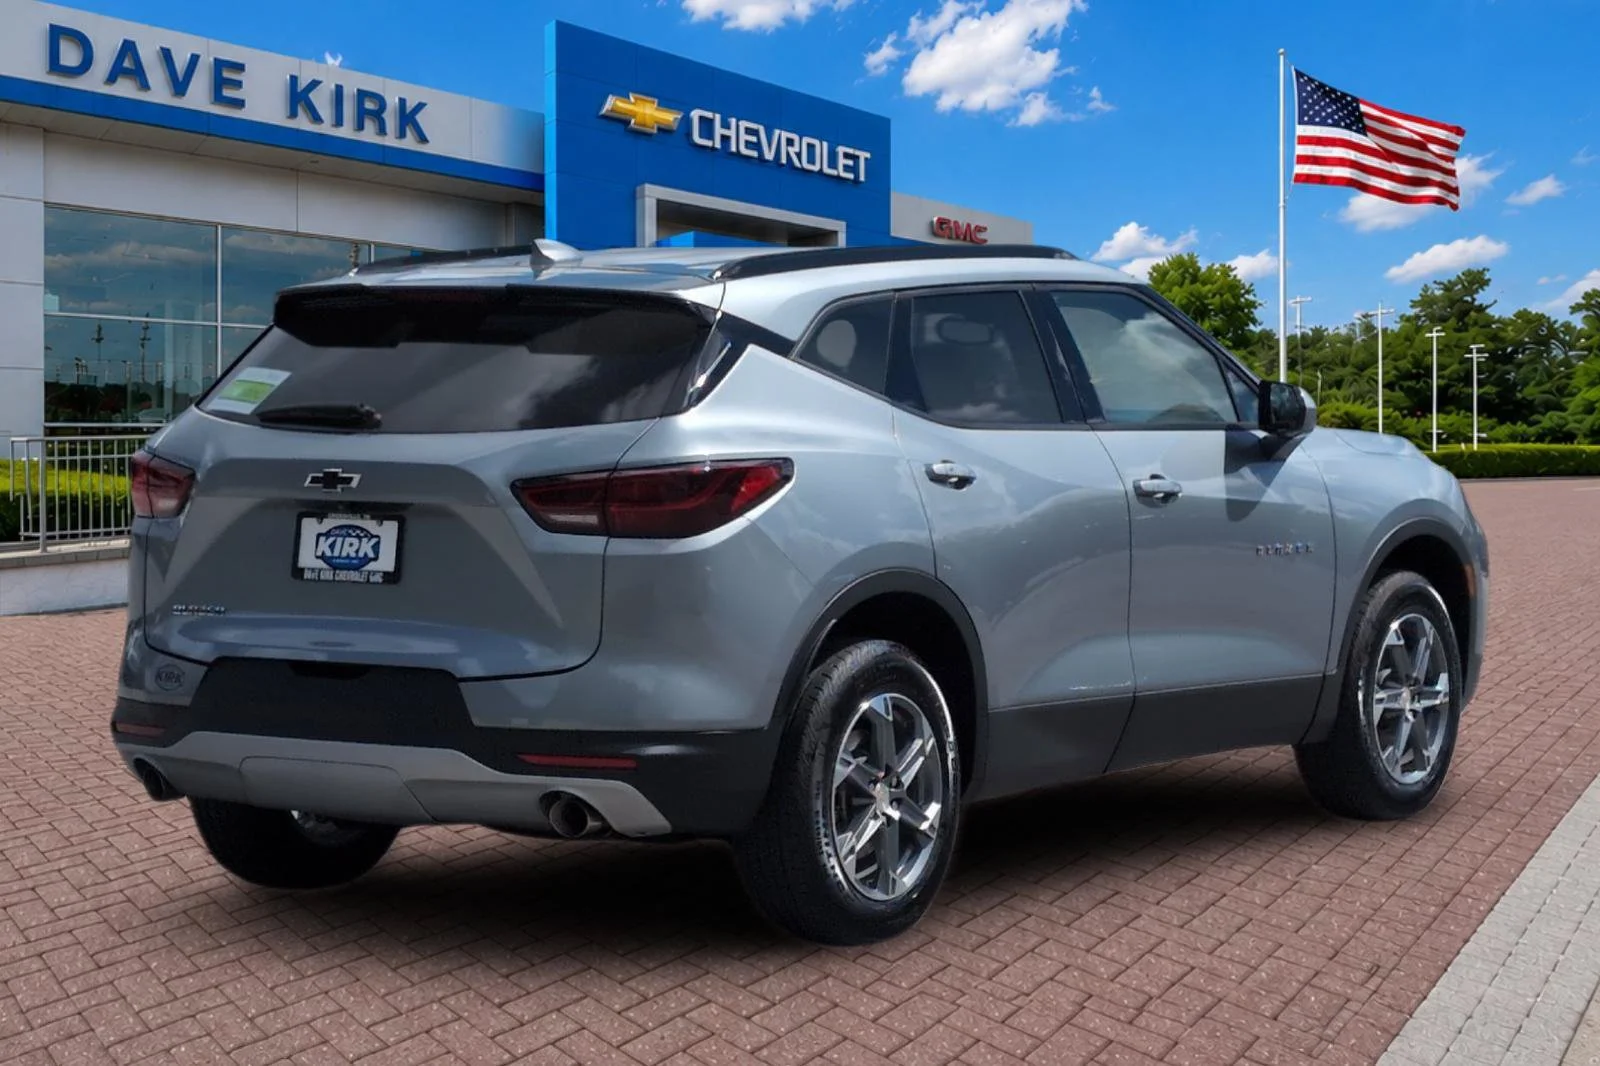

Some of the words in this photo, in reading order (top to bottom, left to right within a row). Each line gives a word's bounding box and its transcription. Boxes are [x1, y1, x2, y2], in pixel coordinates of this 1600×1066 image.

[47, 23, 247, 109] DAVE
[286, 73, 430, 144] KIRK
[690, 108, 871, 183] CHEVROLET
[933, 216, 988, 245] GMC
[316, 536, 379, 558] KIRK
